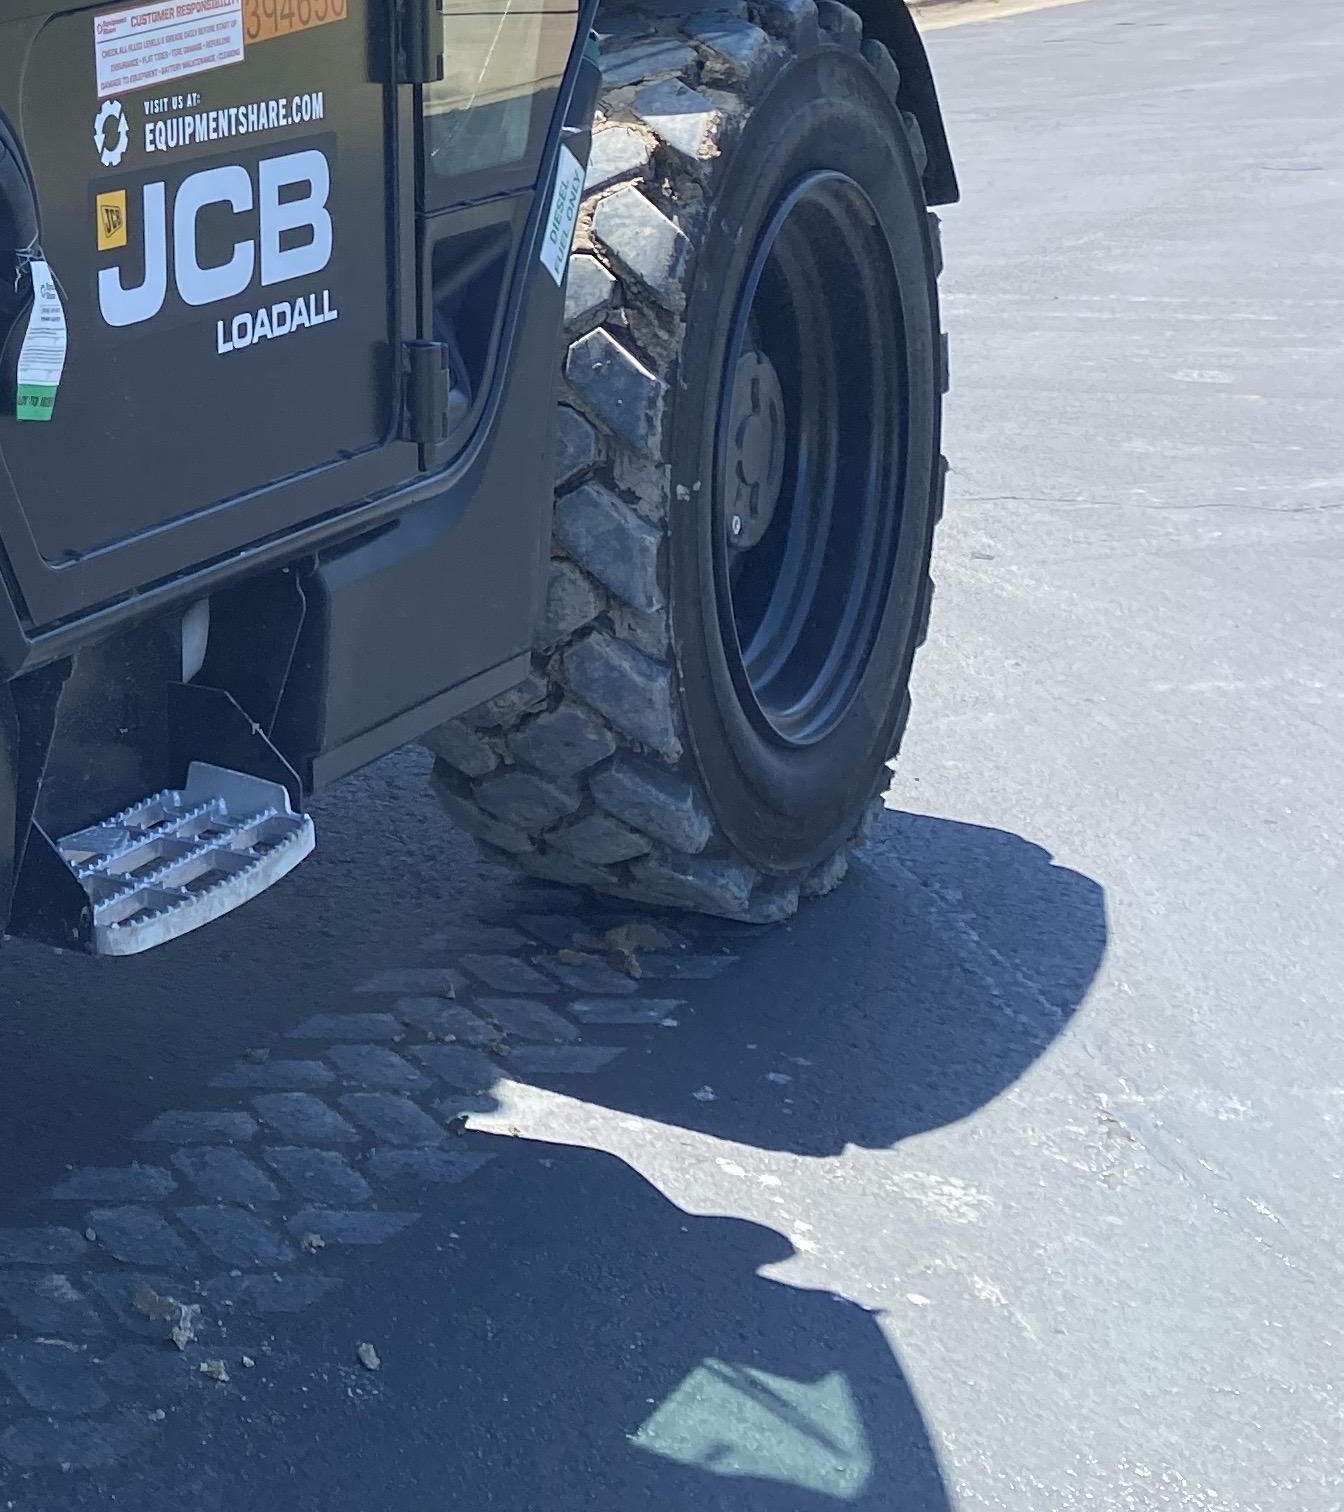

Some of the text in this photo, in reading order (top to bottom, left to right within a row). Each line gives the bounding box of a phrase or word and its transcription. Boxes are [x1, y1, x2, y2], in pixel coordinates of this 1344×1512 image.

[130, 8, 175, 28] CUSTOMER
[144, 93, 201, 115] VISIT US AT:
[144, 91, 324, 152] EQUIPMENTSHARE.COM
[98, 149, 333, 327] JCB
[549, 179, 570, 246] DIESEL
[554, 168, 581, 276] FUEL ONLY
[216, 290, 338, 354] LOADALL
